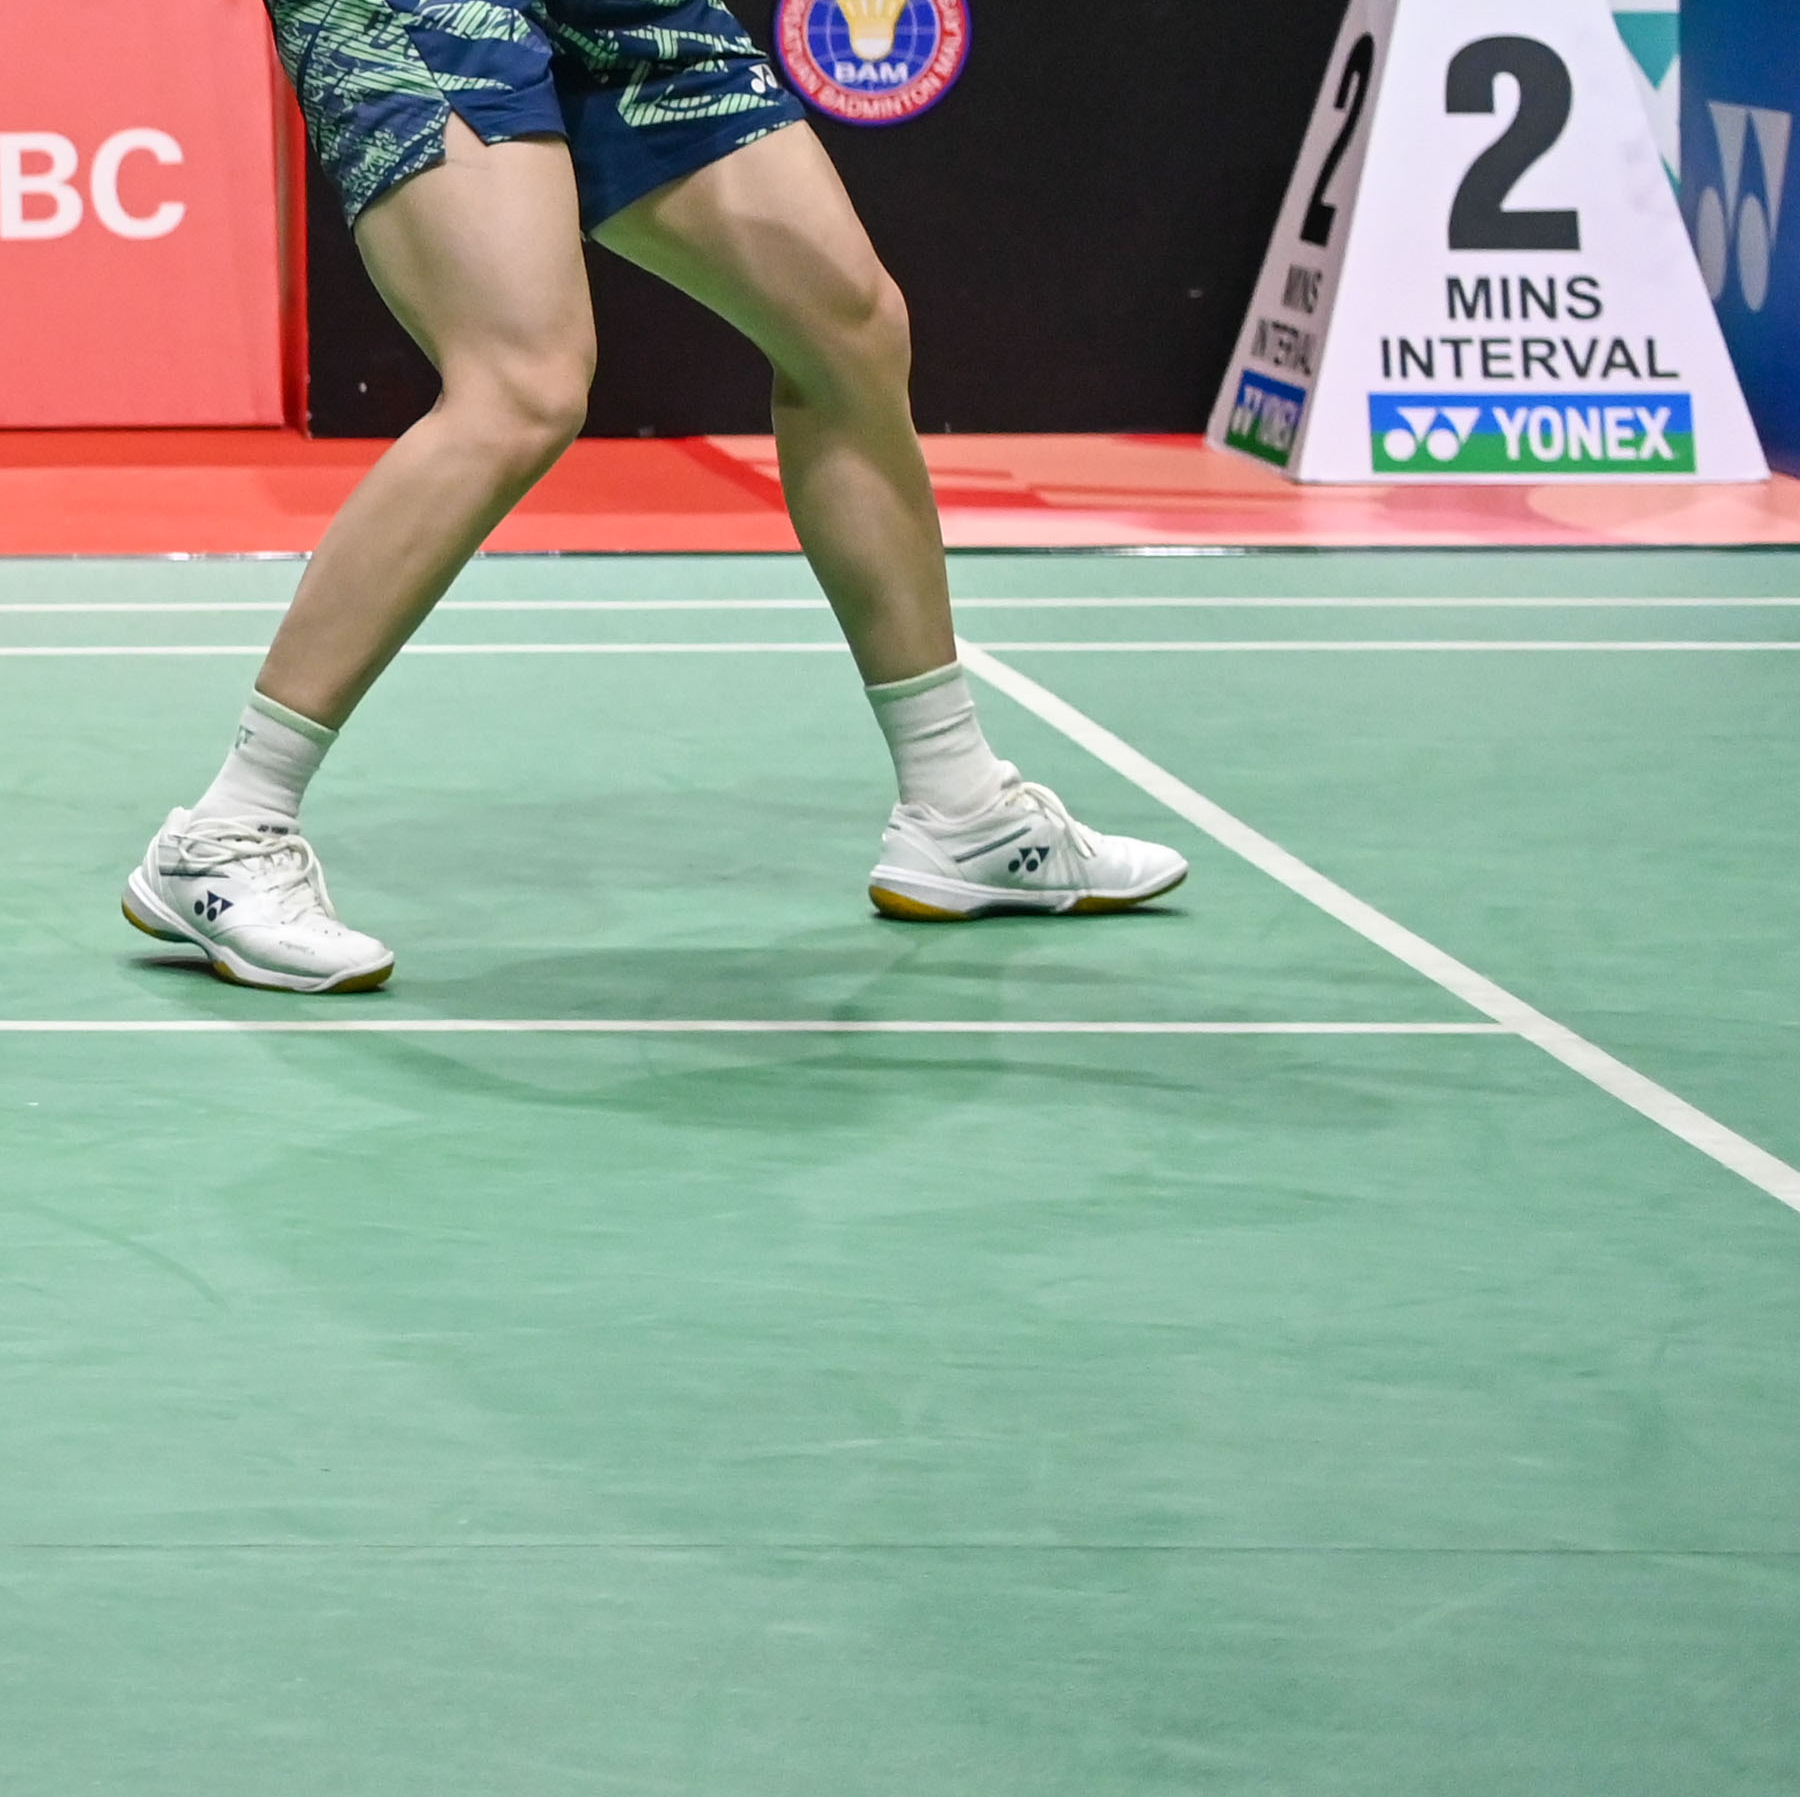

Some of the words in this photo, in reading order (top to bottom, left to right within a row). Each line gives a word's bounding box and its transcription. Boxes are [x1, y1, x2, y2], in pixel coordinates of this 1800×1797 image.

[835, 61, 909, 84] BAM
[1300, 30, 1375, 247] 2
[1444, 34, 1582, 251] 2
[1446, 275, 1602, 322] MINS
[1380, 335, 1680, 380] INTERVAL
[1492, 405, 1676, 463] YONEX
